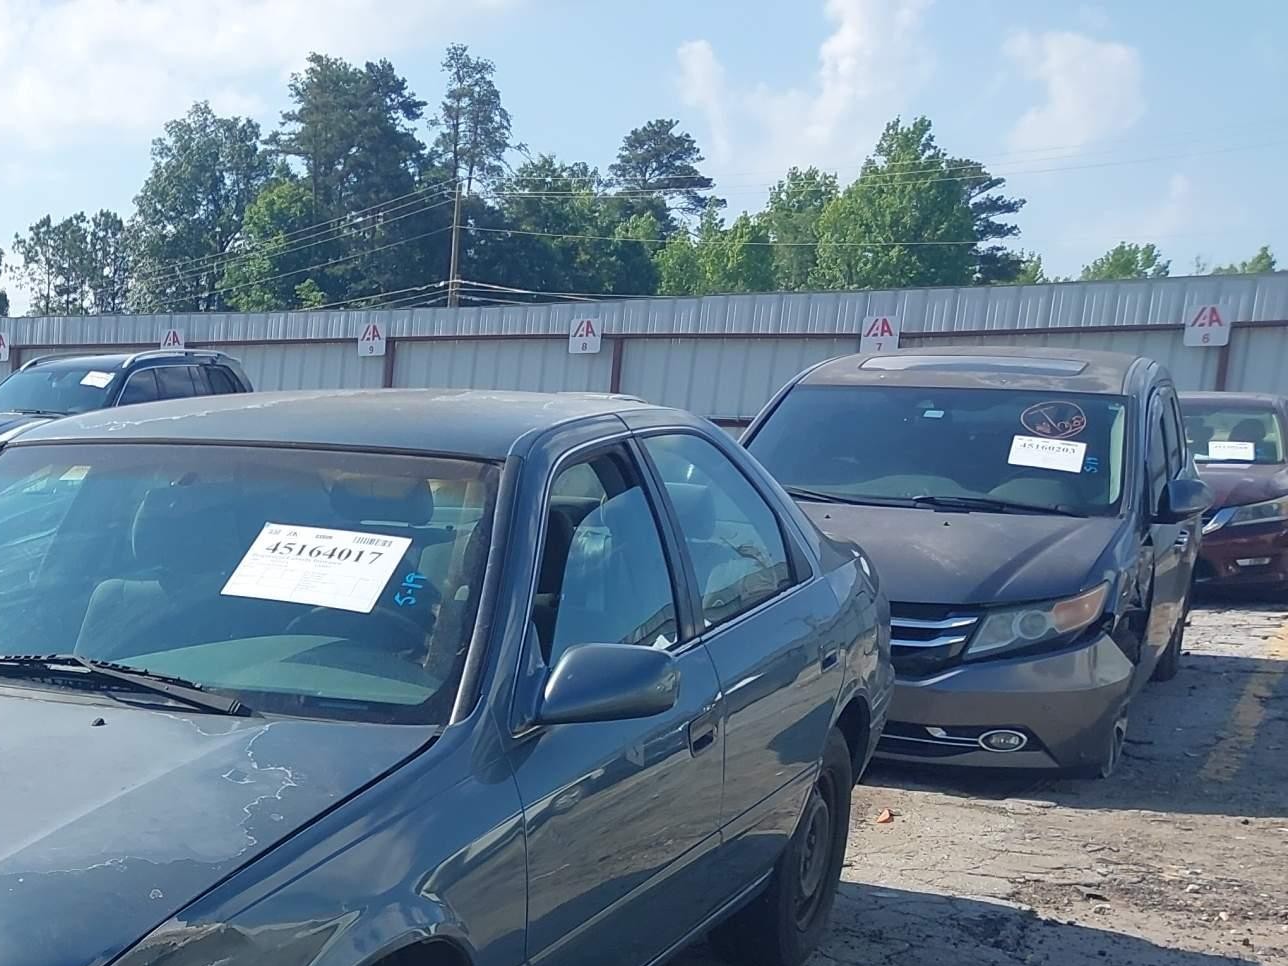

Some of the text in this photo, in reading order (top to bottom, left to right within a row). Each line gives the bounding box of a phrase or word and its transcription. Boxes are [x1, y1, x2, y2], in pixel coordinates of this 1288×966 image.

[1202, 333, 1210, 344] 6
[368, 345, 374, 354] 9
[875, 342, 883, 351] 7
[265, 540, 384, 565] 45164017
